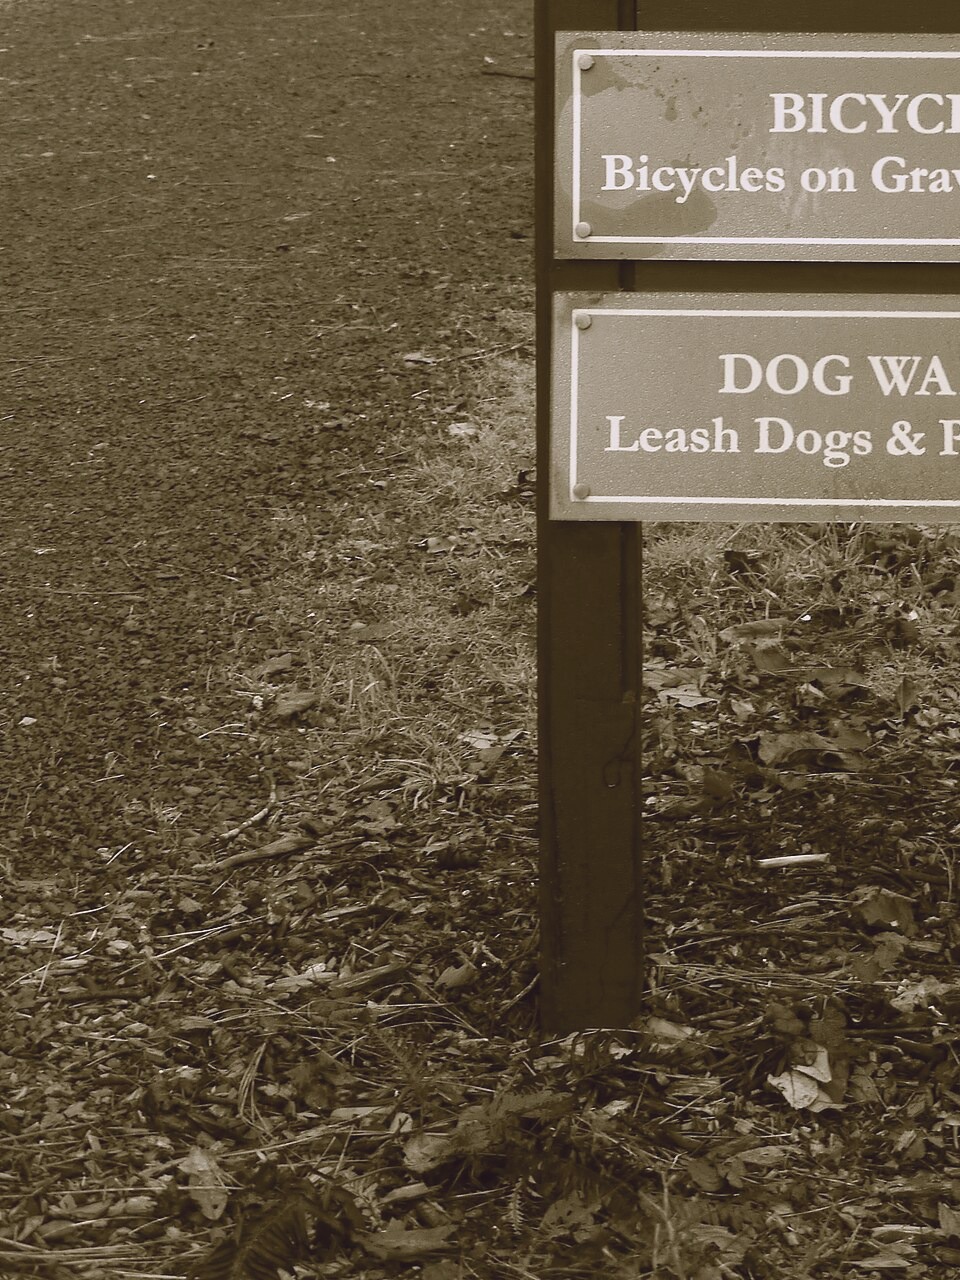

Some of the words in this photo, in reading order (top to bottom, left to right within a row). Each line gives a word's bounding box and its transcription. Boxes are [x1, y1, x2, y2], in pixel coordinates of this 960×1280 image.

[600, 155, 786, 204] Bicycles
[800, 166, 856, 194] on
[718, 354, 854, 397] DOG
[605, 416, 740, 455] Leash
[754, 418, 873, 468] Dogs
[886, 421, 926, 457] &
